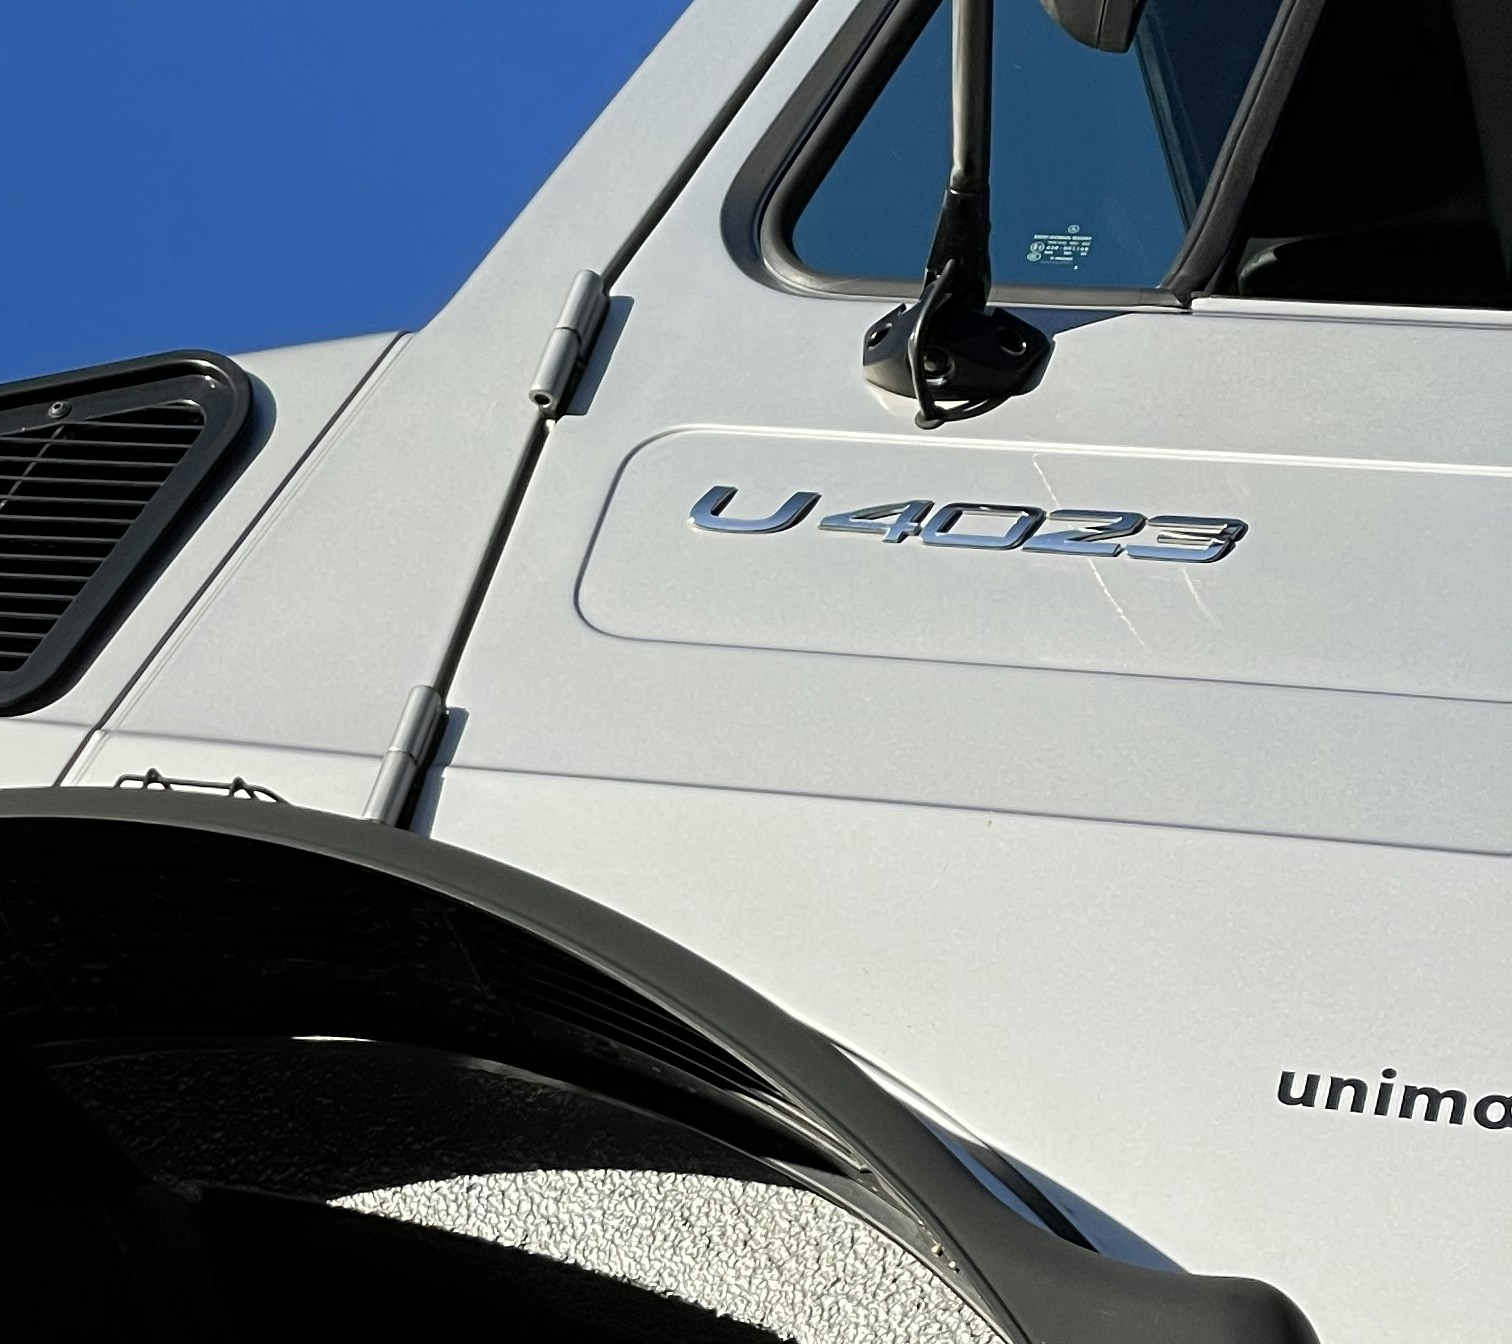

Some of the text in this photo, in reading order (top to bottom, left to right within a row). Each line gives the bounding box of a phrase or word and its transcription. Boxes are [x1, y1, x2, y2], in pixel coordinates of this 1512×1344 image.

[688, 485, 1248, 563] U 4023
[1277, 1068, 1512, 1130] unima
